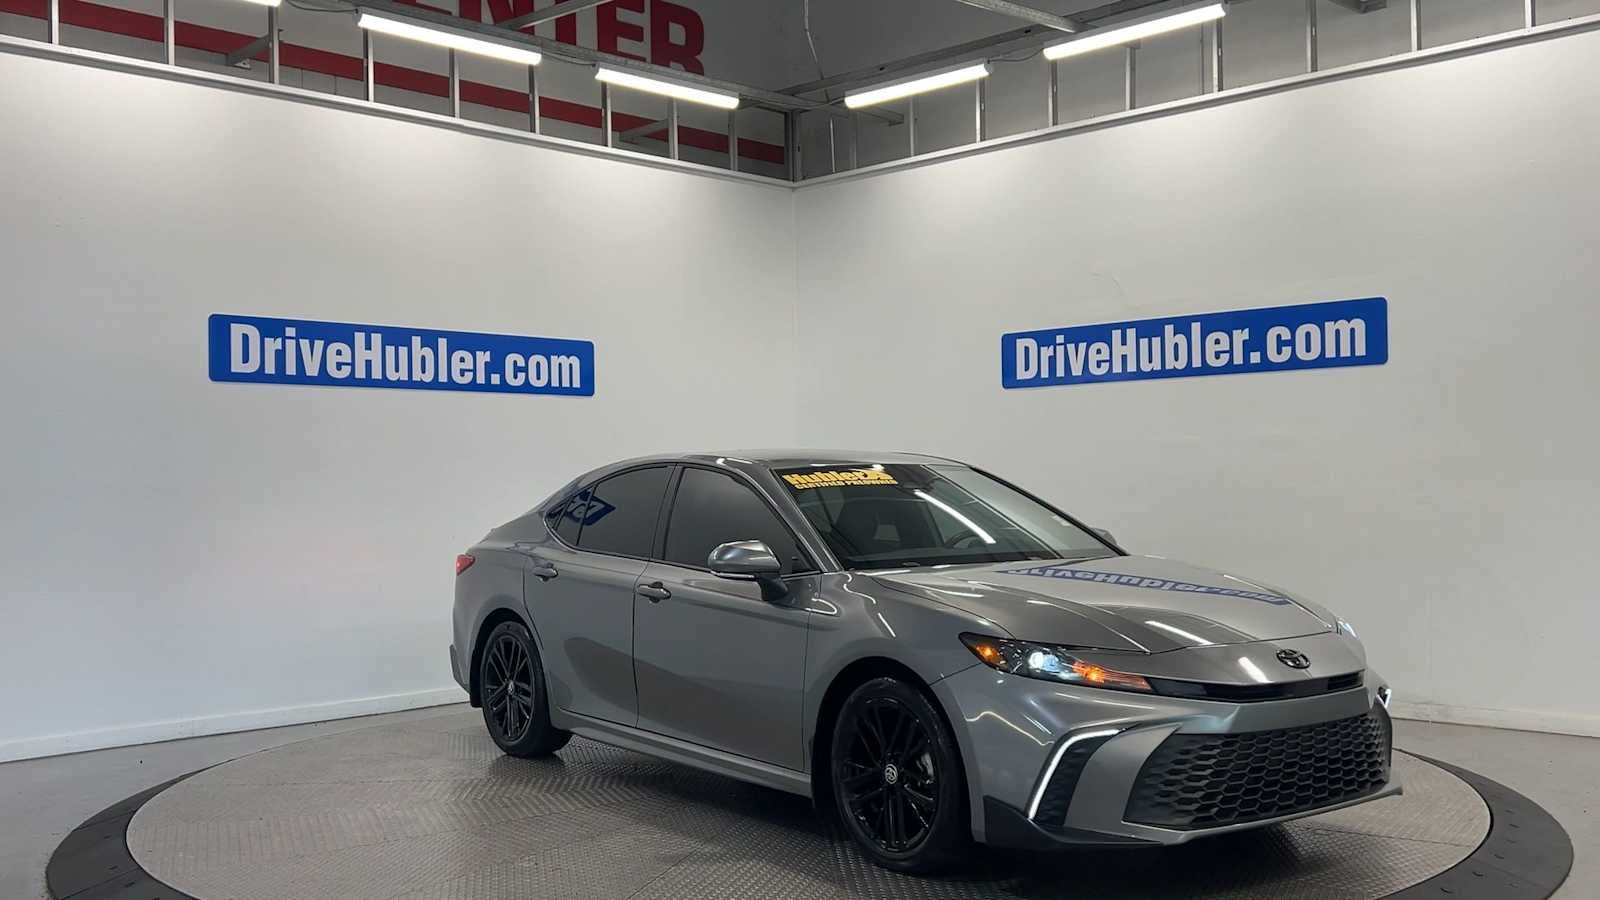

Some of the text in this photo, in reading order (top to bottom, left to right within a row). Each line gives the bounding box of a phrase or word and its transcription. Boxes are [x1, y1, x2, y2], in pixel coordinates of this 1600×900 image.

[230, 322, 581, 388] DriveHubler.com
[1016, 316, 1367, 380] DriveHubler.com
[782, 470, 864, 485] Hubler
